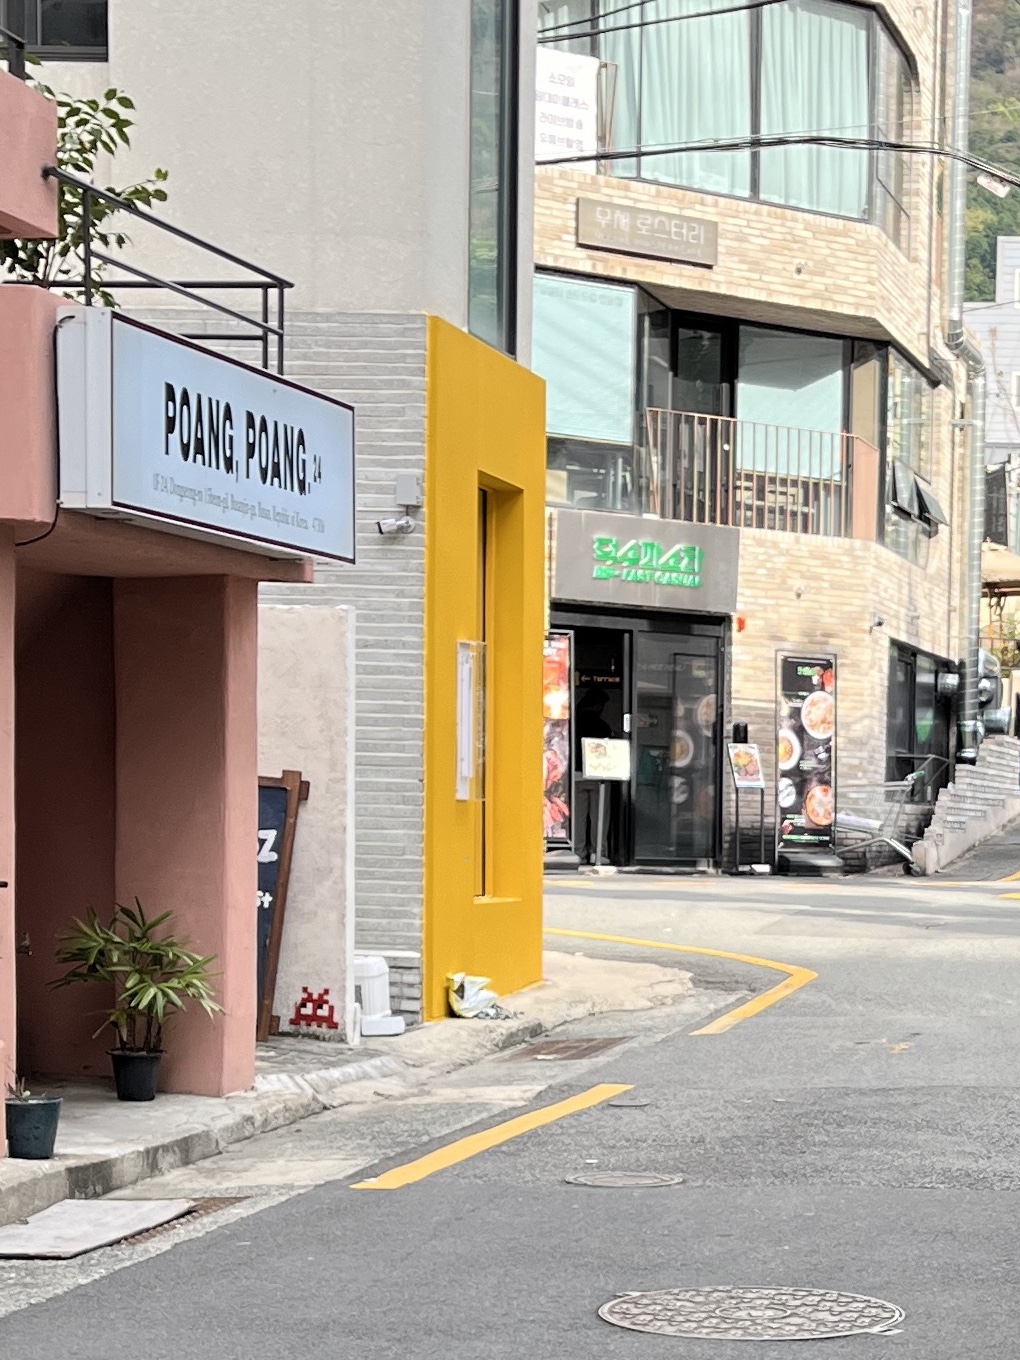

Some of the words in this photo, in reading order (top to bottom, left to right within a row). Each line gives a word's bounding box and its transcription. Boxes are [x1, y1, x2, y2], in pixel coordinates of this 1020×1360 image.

[636, 212, 705, 246] 로스터리
[164, 381, 240, 484] POANG,
[245, 409, 311, 496] POANG.
